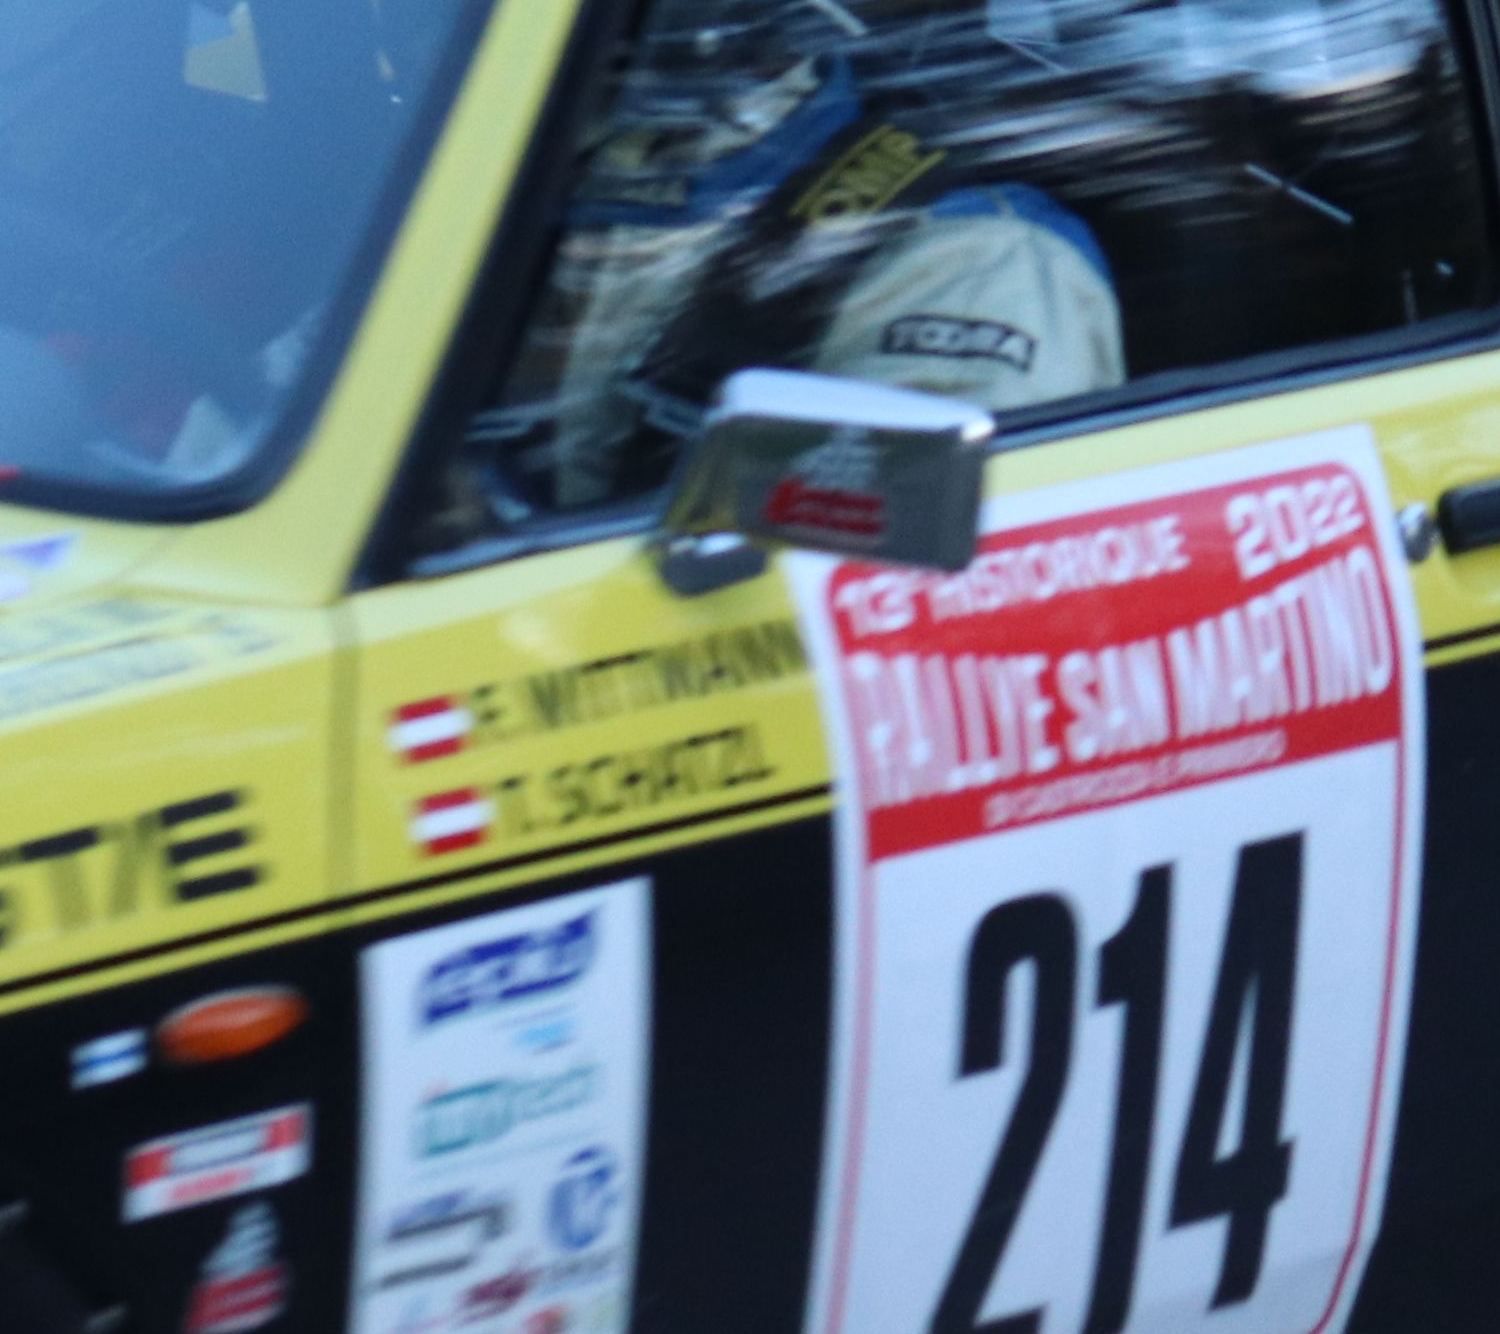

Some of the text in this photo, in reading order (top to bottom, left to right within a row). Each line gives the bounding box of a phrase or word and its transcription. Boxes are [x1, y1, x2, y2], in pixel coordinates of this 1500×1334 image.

[1225, 473, 1367, 581] 2022
[847, 545, 1393, 810] RALLYE SAN MARTINO
